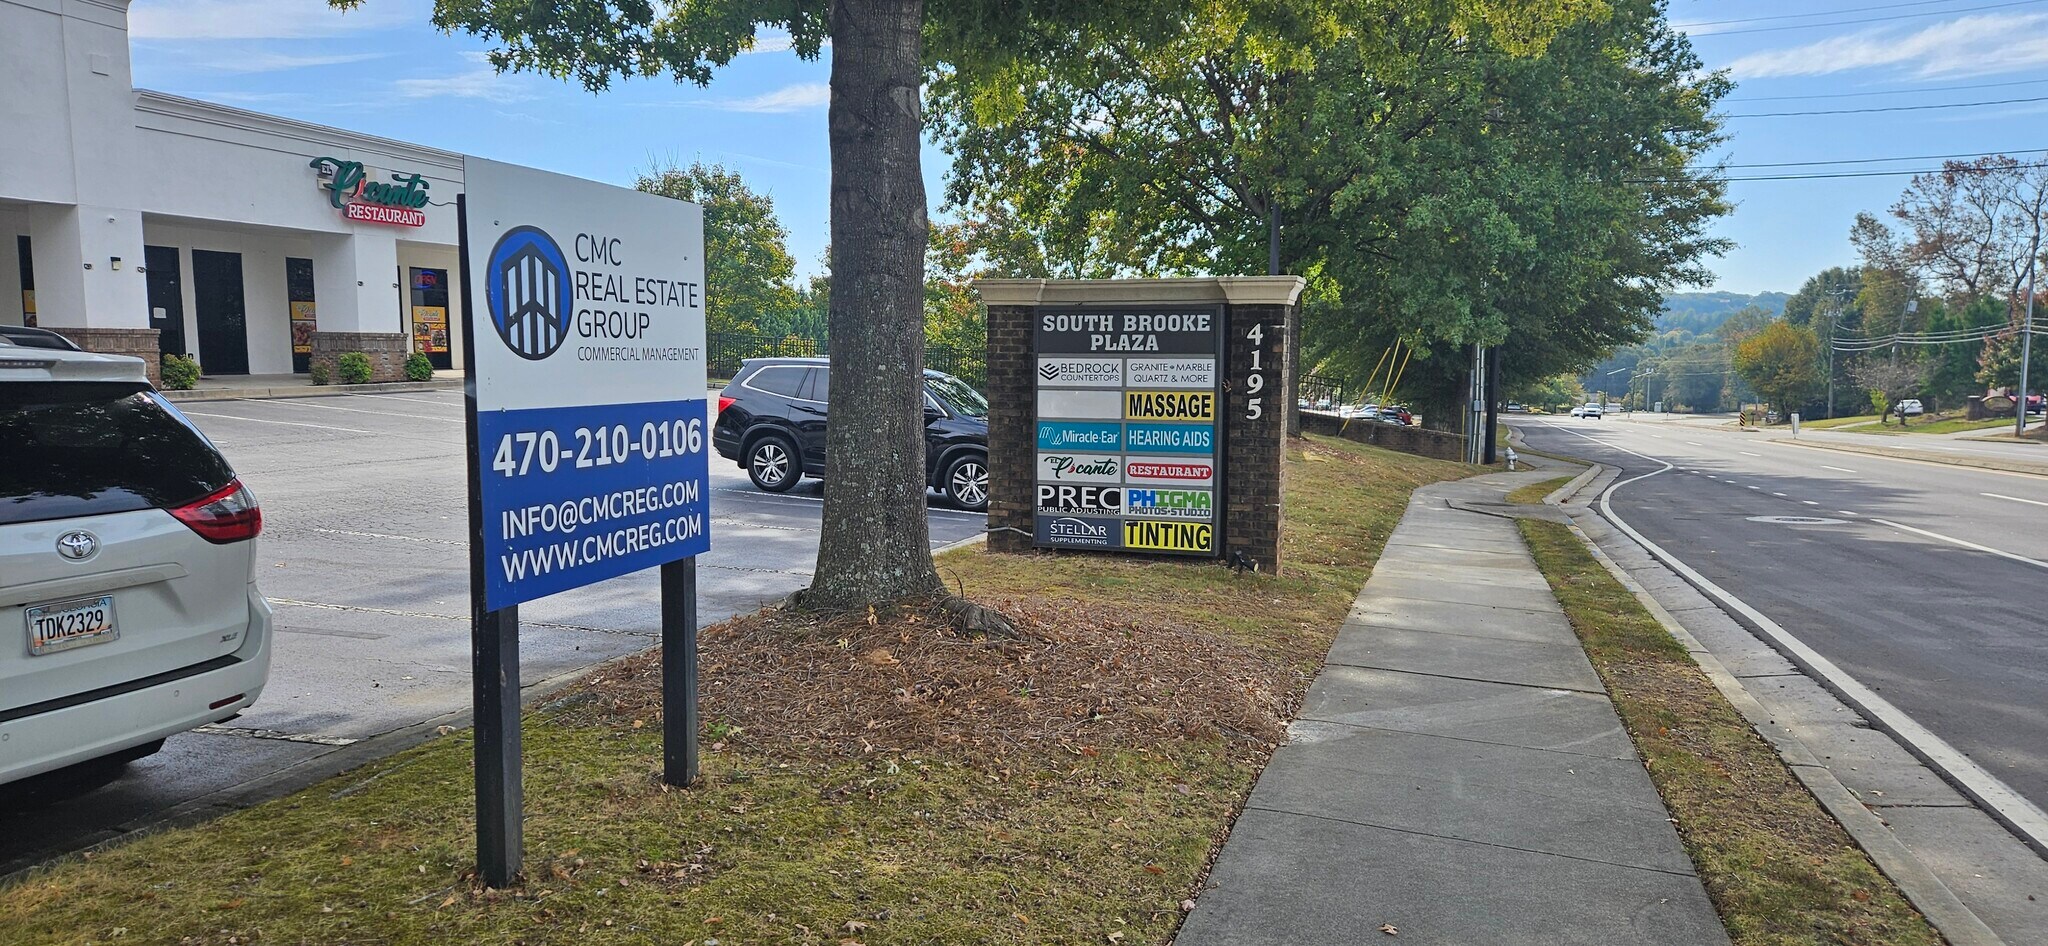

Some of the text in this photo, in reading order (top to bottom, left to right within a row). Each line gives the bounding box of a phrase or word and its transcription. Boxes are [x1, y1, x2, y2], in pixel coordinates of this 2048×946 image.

[347, 204, 424, 226] RESTAURANT
[575, 232, 622, 267] CMC
[576, 270, 698, 308] REAL ESTATE
[577, 308, 650, 340] GROUP
[1042, 314, 1211, 332] SOUTH BROOKE
[1090, 334, 1159, 351] PLAZA
[577, 345, 699, 362] COMMERCIAL MANAGEMENT
[1060, 363, 1120, 374] BEDROCK
[1060, 374, 1120, 382] COUNTERTOPS
[1133, 374, 1208, 383] QUARTZ & MORE
[1129, 393, 1211, 418] MASSAGE
[1062, 430, 1119, 444] Miracle-Ear
[1129, 430, 1210, 447] HEARING AIDS
[493, 418, 702, 478] 470-210-0106
[1129, 465, 1210, 478] RESTAURANT
[1037, 485, 1120, 509] PREC
[1128, 490, 1211, 508] PHIGMA
[502, 479, 699, 540] INFO@CMCREG.COM
[1069, 507, 1120, 516] ADJUSTING
[1050, 523, 1107, 536] STELLAR
[1125, 521, 1211, 550] TINTING
[501, 512, 702, 583] WWW.CMCREG.COM
[1050, 536, 1108, 545] SUPPLEMENTING
[36, 609, 104, 641] TDK2329
